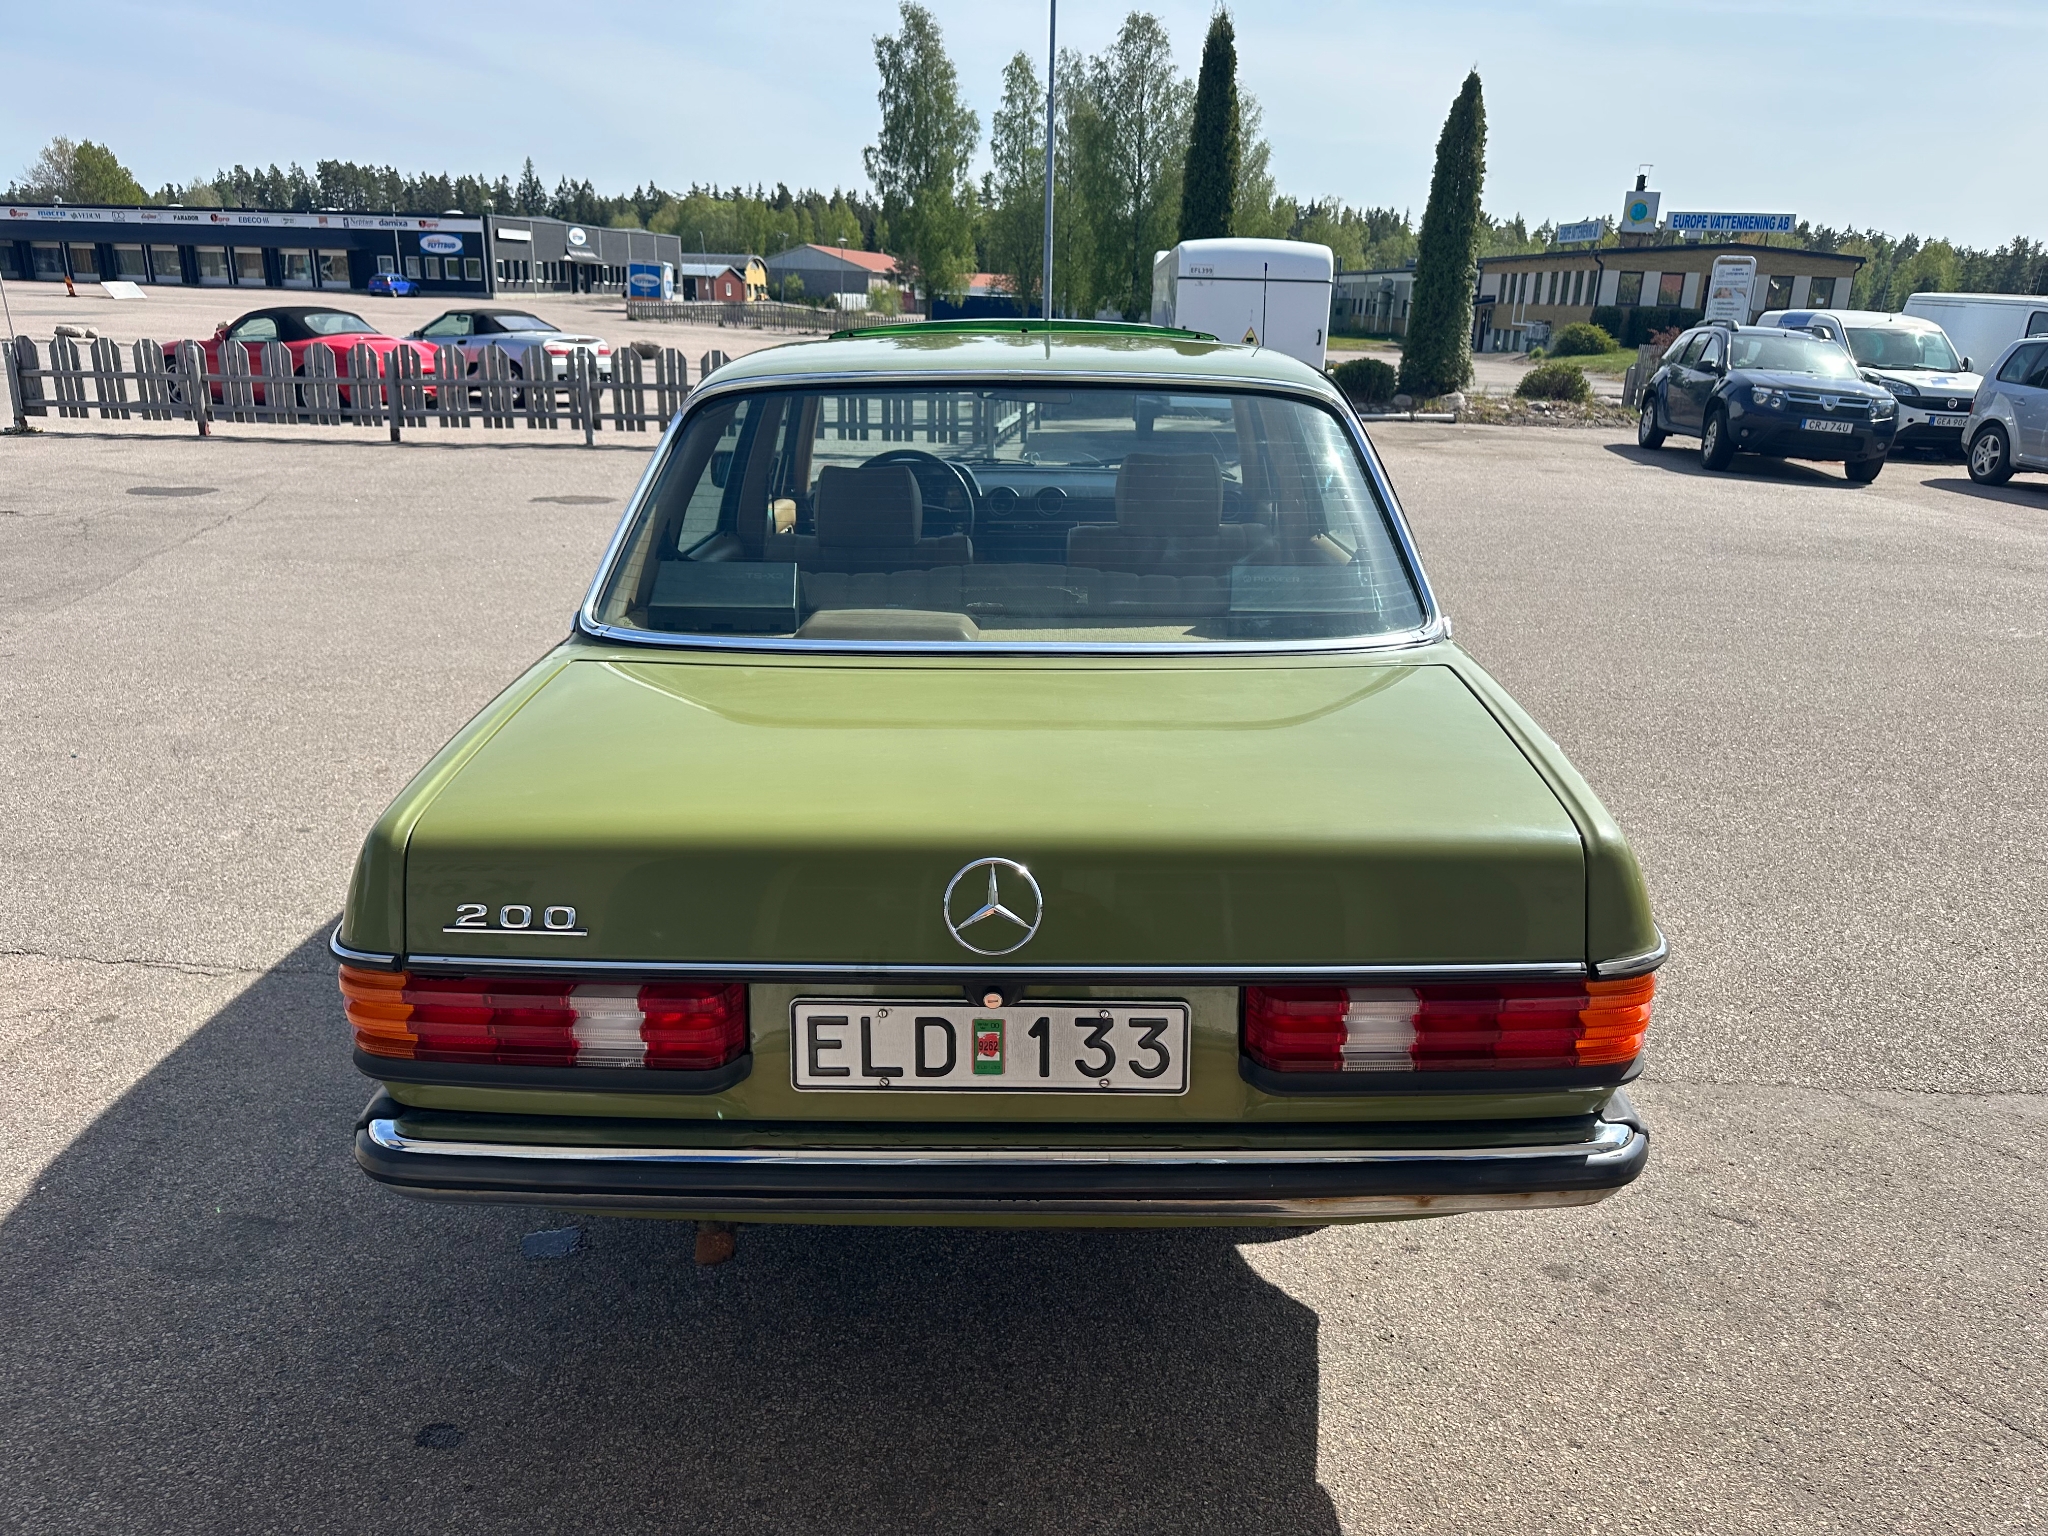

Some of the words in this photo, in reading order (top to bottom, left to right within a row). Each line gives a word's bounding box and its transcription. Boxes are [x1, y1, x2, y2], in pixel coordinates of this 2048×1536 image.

[238, 216, 262, 224] EBECO
[378, 219, 408, 227] damixa
[1672, 214, 1708, 229] EUROPE
[1710, 215, 1776, 230] VATTENRENING
[1777, 216, 1790, 230] AB
[1809, 420, 1829, 431] CRJ
[1936, 417, 1951, 426] GEA
[1253, 575, 1301, 583] PIONEER
[455, 902, 577, 930] 200
[806, 1015, 957, 1078] ELD
[1027, 1016, 1171, 1079] 133
[978, 1040, 999, 1052] 9262
